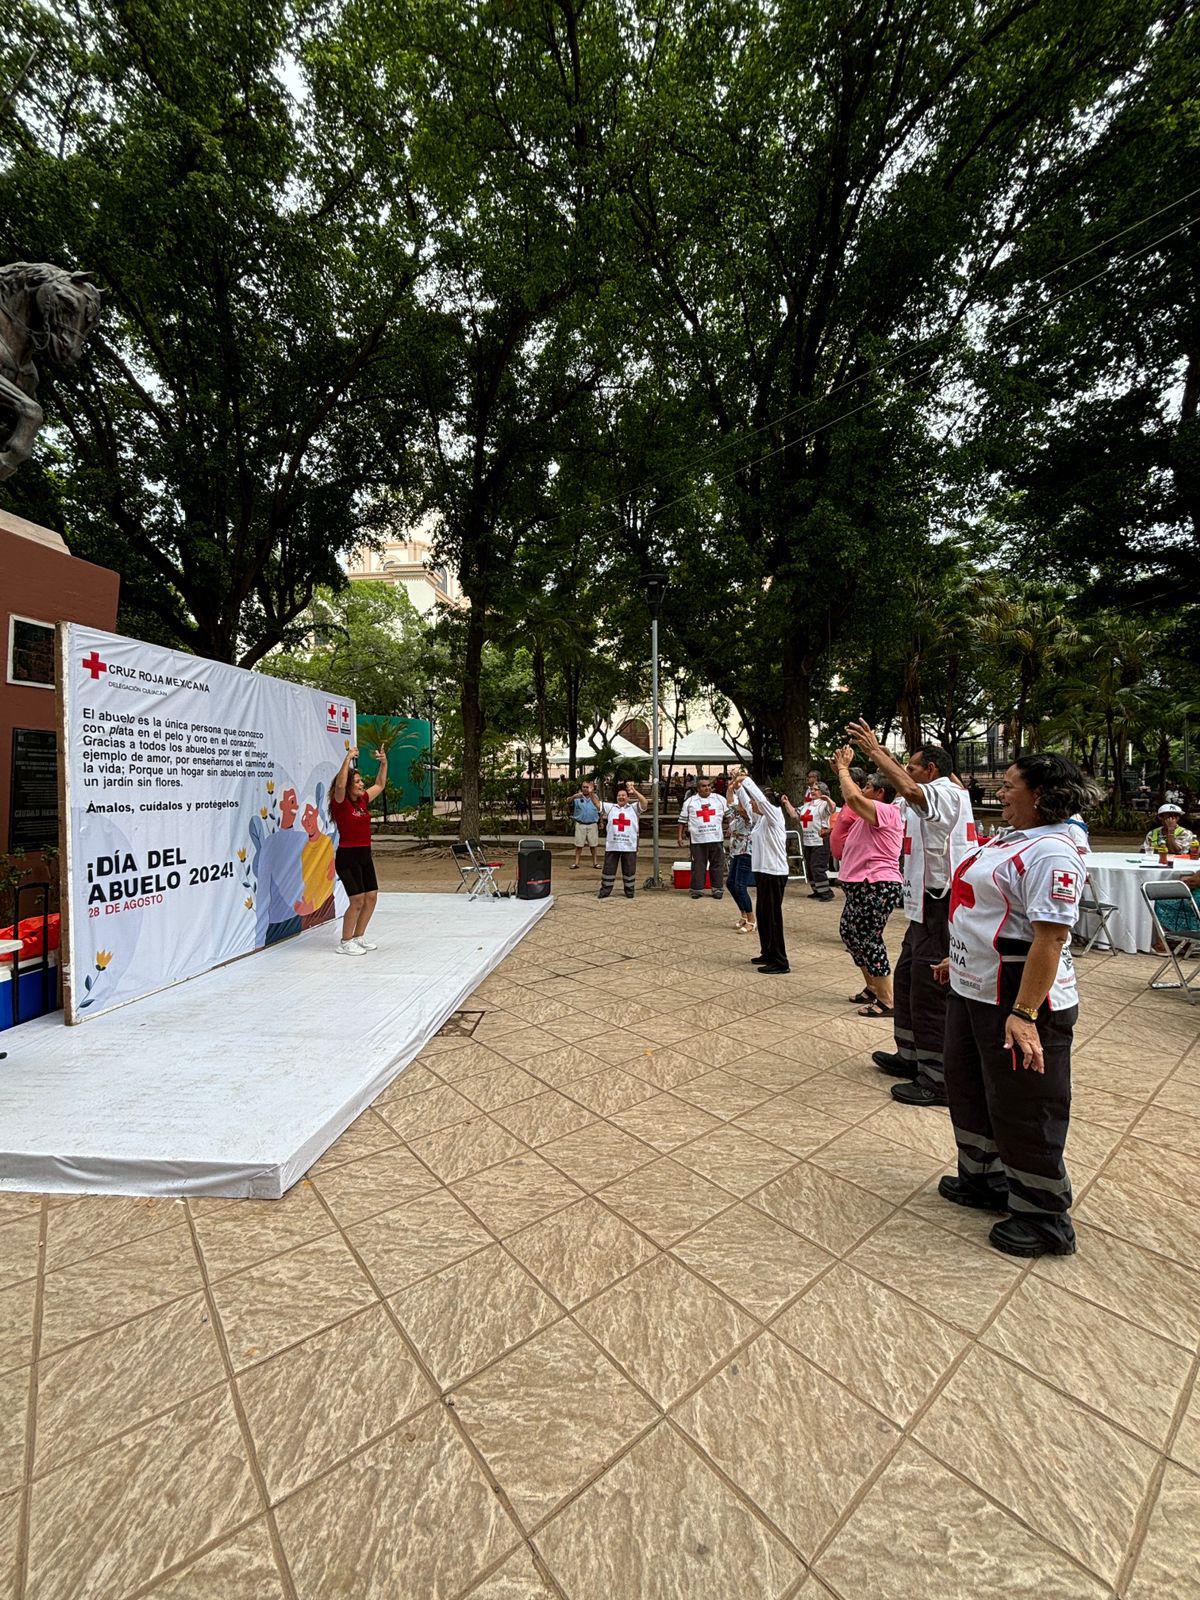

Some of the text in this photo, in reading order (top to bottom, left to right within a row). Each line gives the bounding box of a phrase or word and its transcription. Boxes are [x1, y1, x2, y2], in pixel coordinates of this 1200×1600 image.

[108, 664, 210, 693] CRUZ ROJA MEXICANA
[108, 681, 141, 692] DELEGACIÓN
[83, 708, 264, 739] El abuelo es la única persona que conozco
[83, 724, 105, 734] con
[109, 725, 134, 736] plata
[138, 729, 149, 738] en
[153, 730, 161, 739] el
[165, 731, 183, 741] pelo
[186, 734, 191, 743] y
[194, 735, 208, 743] oro
[221, 737, 228, 745] el
[83, 735, 268, 760] Gracias a todos los abuelos por ser el mejor
[83, 749, 275, 768] ejemplo de amor, por enseñarnos el camino de
[83, 762, 93, 773] la
[98, 763, 125, 775] vida;
[129, 764, 163, 777] Porque
[167, 767, 178, 775] un
[181, 766, 204, 778] hogar
[207, 768, 218, 776] sin
[220, 768, 246, 777] abuelos
[84, 776, 183, 789] un jardín sin flores.
[86, 800, 239, 814] Ámalos, cuídalos y protégelos
[87, 847, 187, 883] ¡DÍA DEL
[88, 861, 234, 905] ABUELO 2024!
[88, 894, 163, 918] 28 DE AGOSTO
